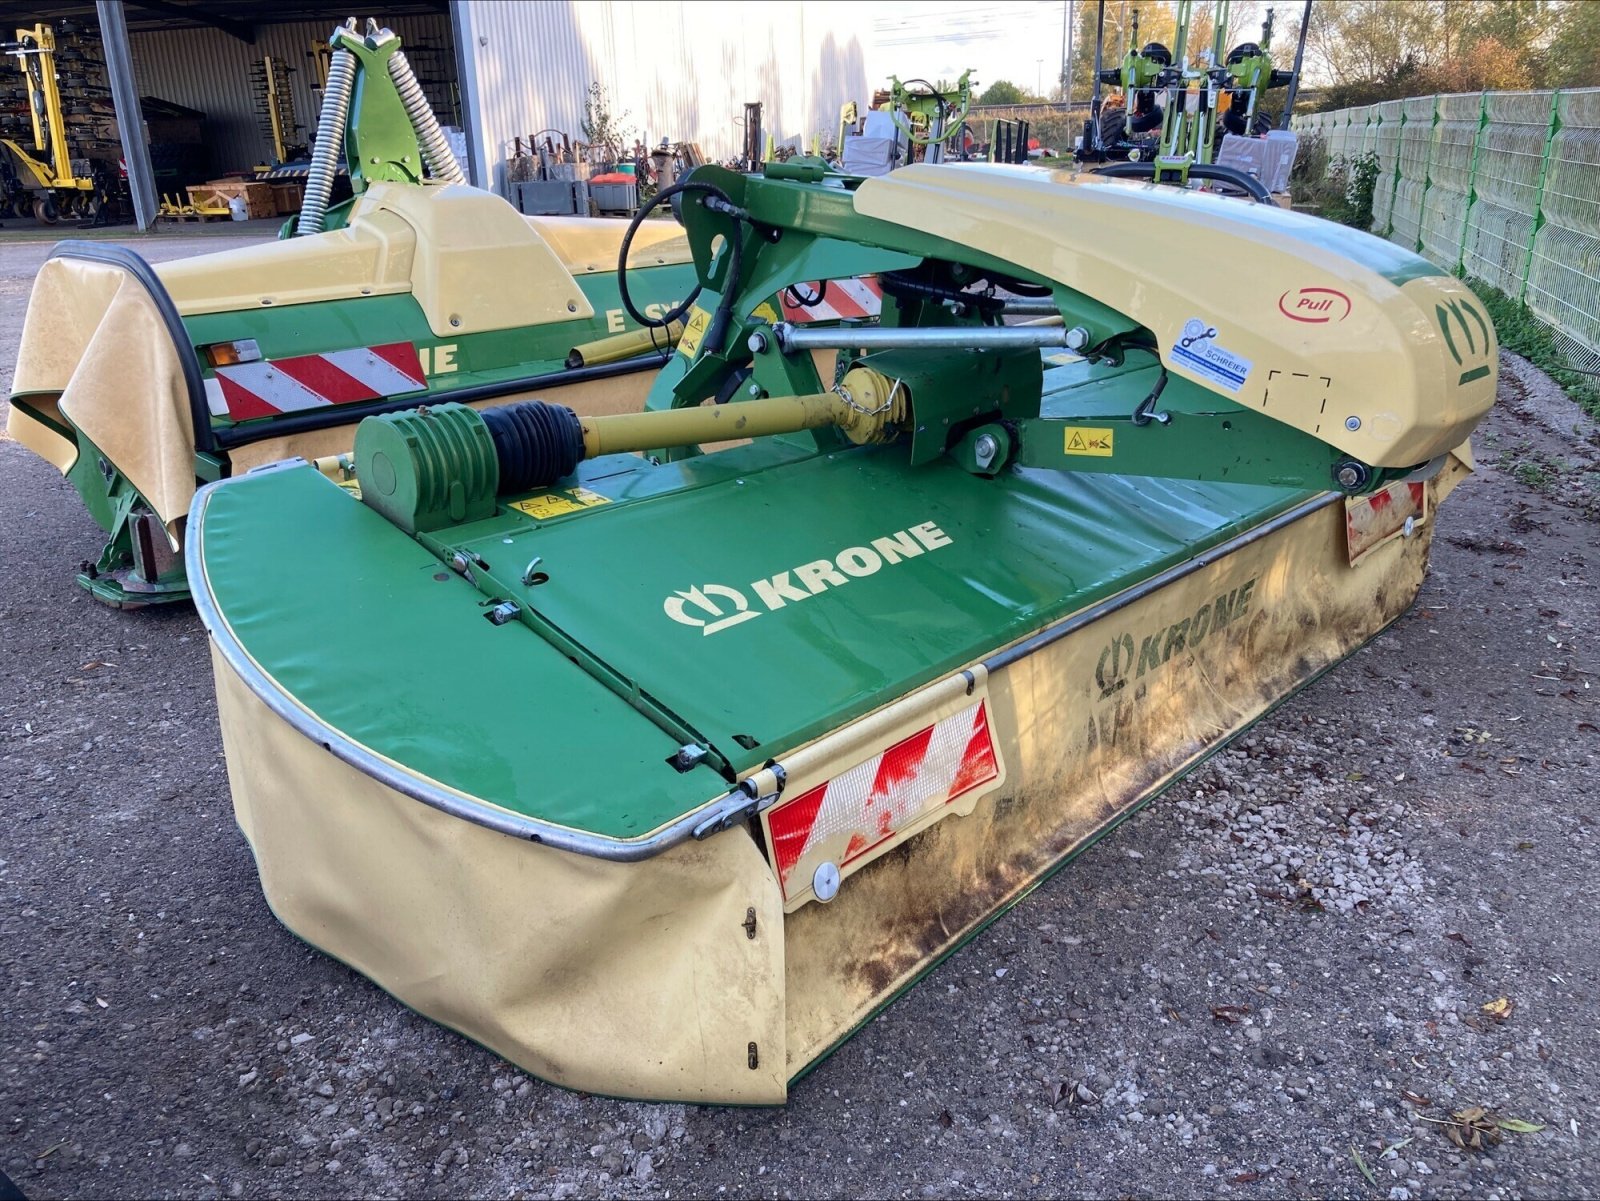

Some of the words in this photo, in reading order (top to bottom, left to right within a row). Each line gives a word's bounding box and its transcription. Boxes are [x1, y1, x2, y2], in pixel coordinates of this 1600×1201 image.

[1297, 298, 1333, 311] Pull
[1205, 349, 1247, 375] SCHREIER
[750, 520, 954, 611] KRONE
[1135, 578, 1257, 680] KRONE
